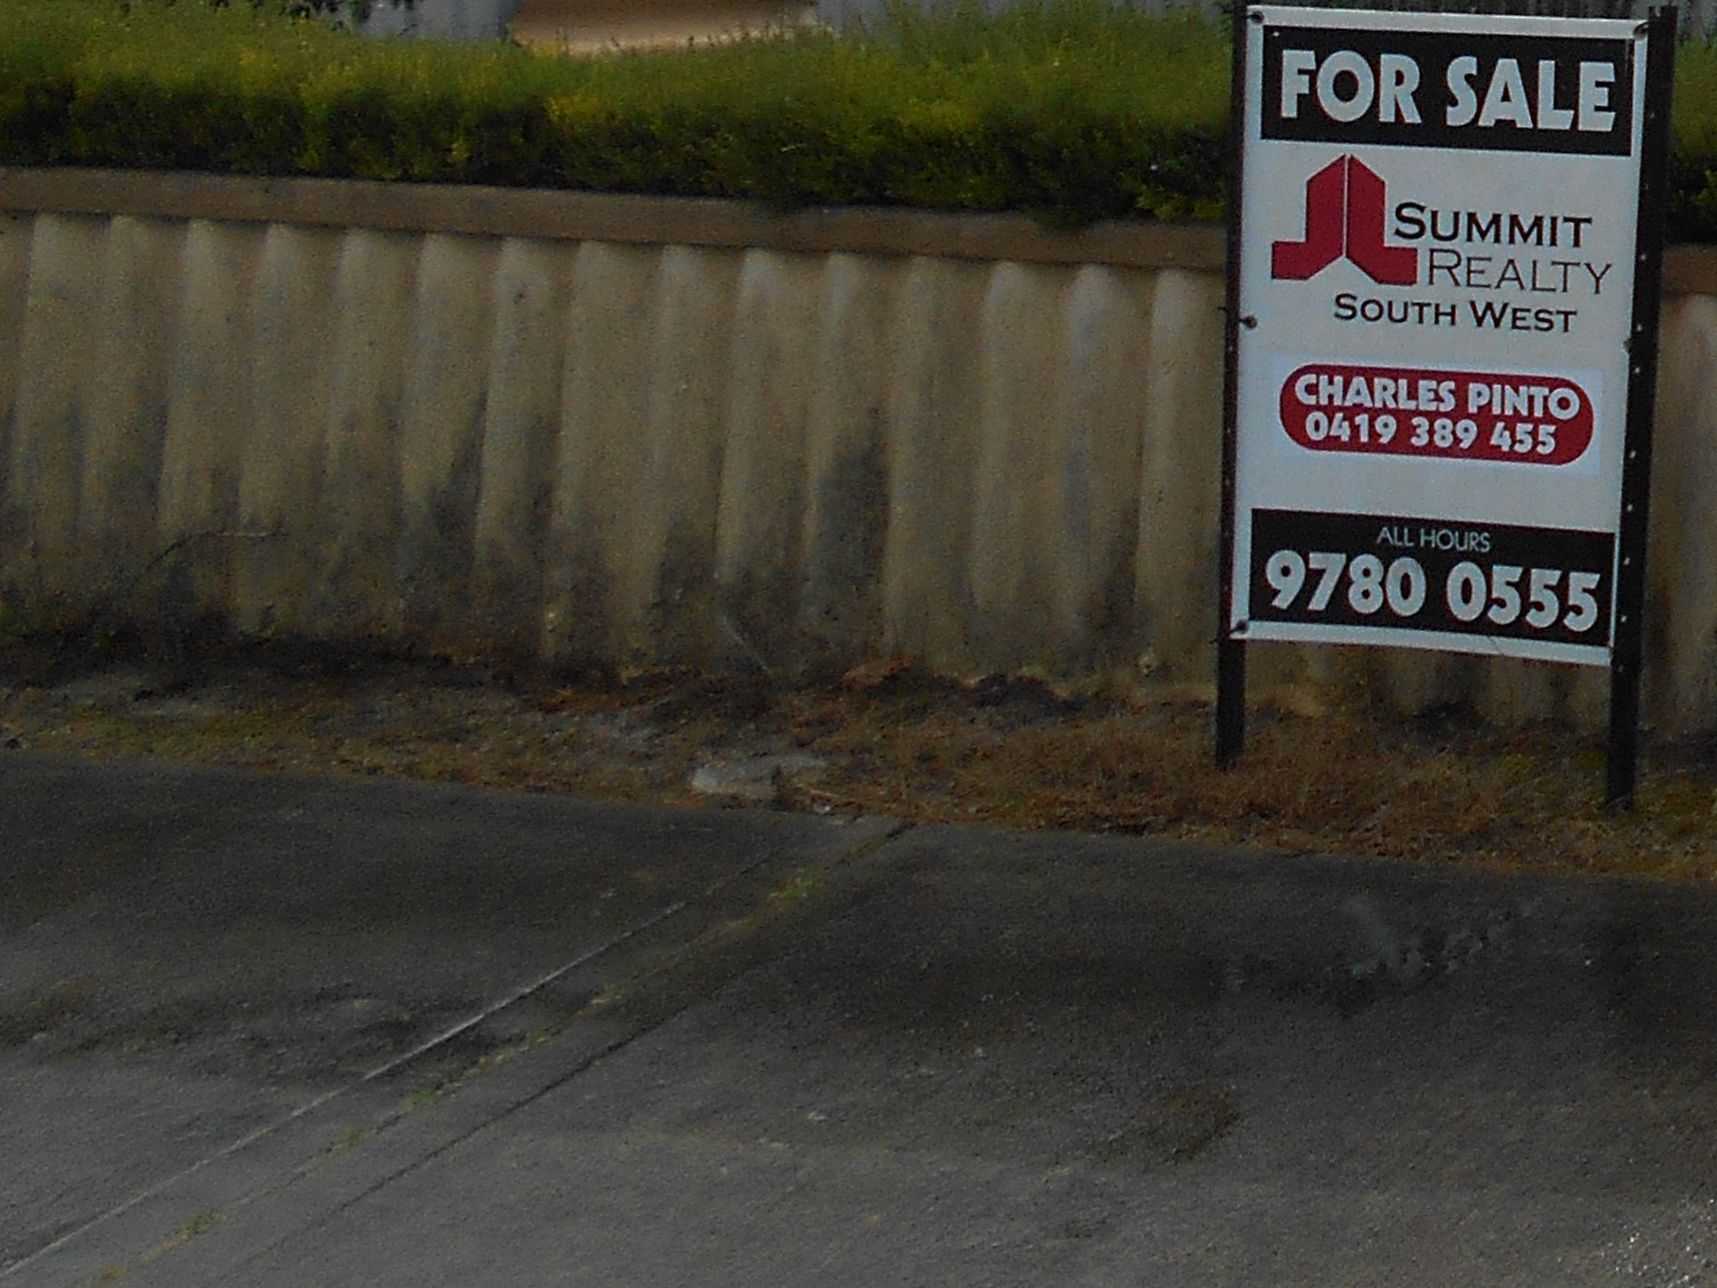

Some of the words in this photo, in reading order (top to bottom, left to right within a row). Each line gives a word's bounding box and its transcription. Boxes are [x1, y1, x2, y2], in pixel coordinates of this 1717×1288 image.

[1281, 49, 1422, 124] FOR
[1446, 56, 1615, 132] SALE
[1393, 202, 1592, 248] SUMMIT
[1427, 248, 1612, 294] REALTY
[1334, 294, 1457, 326] SOUTH
[1469, 301, 1577, 333] WEST
[1295, 374, 1456, 413] CHARLES
[1468, 382, 1580, 421] PINTO
[1305, 412, 1397, 444] 0419
[1410, 417, 1478, 450] 389
[1490, 422, 1557, 456] 455
[1377, 527, 1413, 549] ALL
[1420, 529, 1491, 553] HOURS
[1265, 549, 1427, 616] 9780
[1446, 561, 1600, 632] 0555
